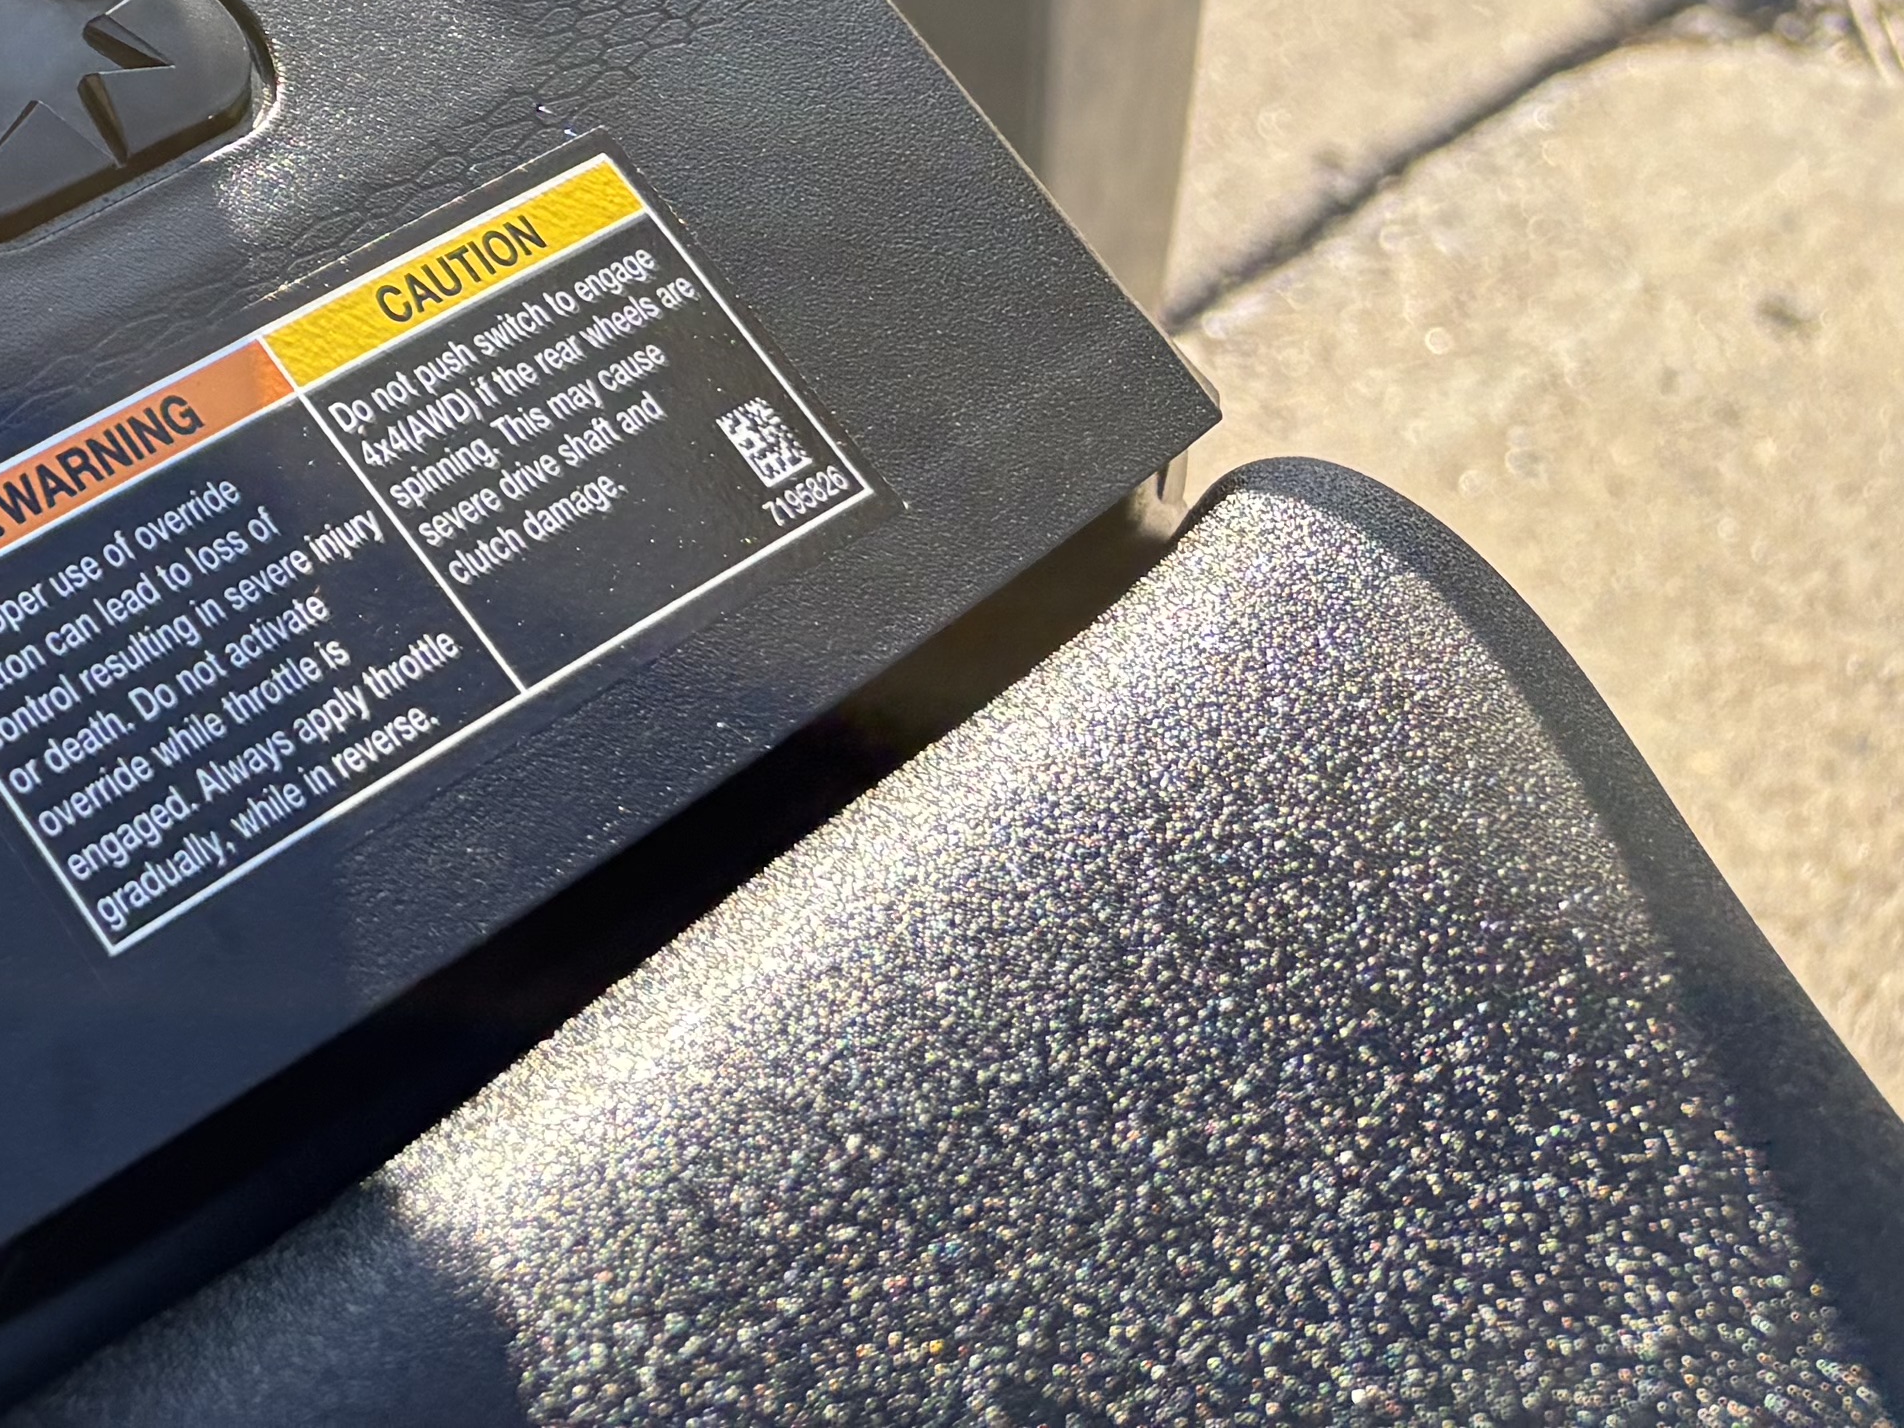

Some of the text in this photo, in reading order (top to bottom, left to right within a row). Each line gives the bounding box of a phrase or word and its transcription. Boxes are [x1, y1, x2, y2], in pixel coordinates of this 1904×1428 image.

[326, 248, 655, 434] Do not push switch to engage
[374, 213, 548, 323] CAUTION
[360, 276, 699, 467] 4x4(AWD) if the rear wheels are
[388, 343, 666, 509] spinning. This may cause
[48, 555, 103, 597] use
[102, 529, 136, 568] of
[133, 480, 240, 550] override
[417, 389, 667, 547] severe drive shaft and
[447, 474, 626, 584] clutch damage.
[760, 464, 849, 527] 7195826
[44, 612, 101, 656] can
[92, 571, 162, 626] lead
[154, 561, 192, 592] to
[183, 529, 249, 574] loss
[246, 504, 280, 543] of
[77, 613, 201, 694] resulting
[188, 597, 226, 627] in
[222, 549, 313, 611] severe
[302, 509, 384, 564] injury
[8, 588, 329, 794] or death. Do not activate
[37, 639, 350, 837] override while throttle is
[66, 632, 459, 881] engaged. Always apply throttle
[96, 706, 439, 931] gradually, while in reverse.
